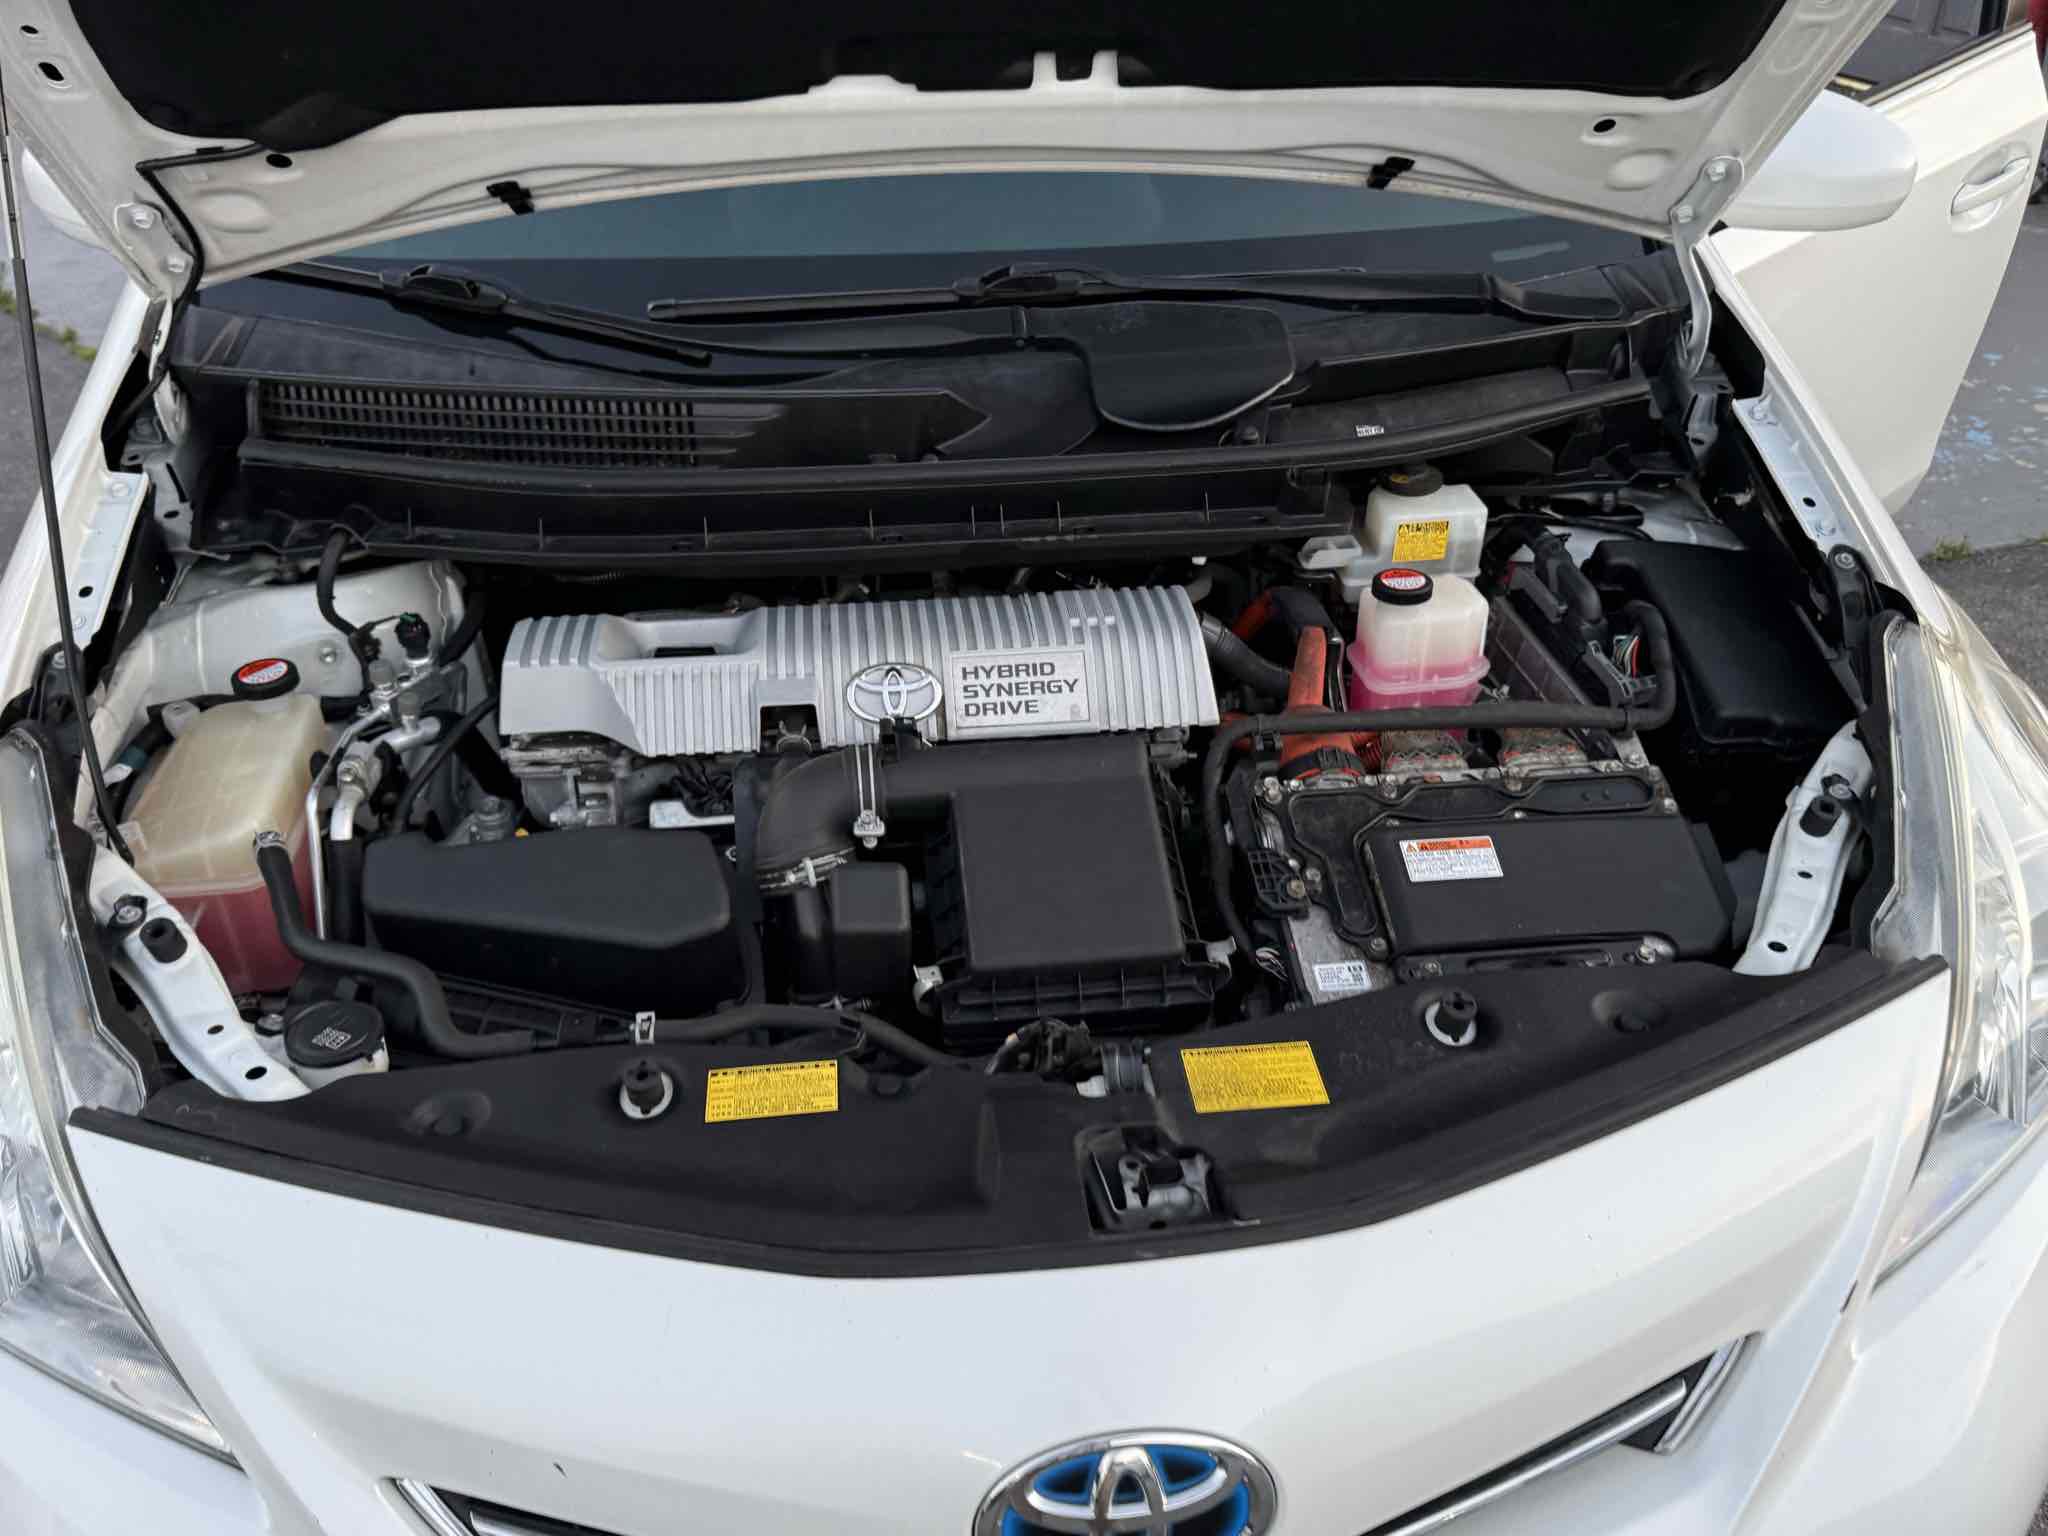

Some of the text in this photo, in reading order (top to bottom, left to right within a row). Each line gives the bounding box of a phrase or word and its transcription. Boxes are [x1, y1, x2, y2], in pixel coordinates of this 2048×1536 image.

[962, 662, 1056, 680] HYBRID
[963, 679, 1078, 699] SYNERGY
[964, 699, 1039, 717] DRIVE
